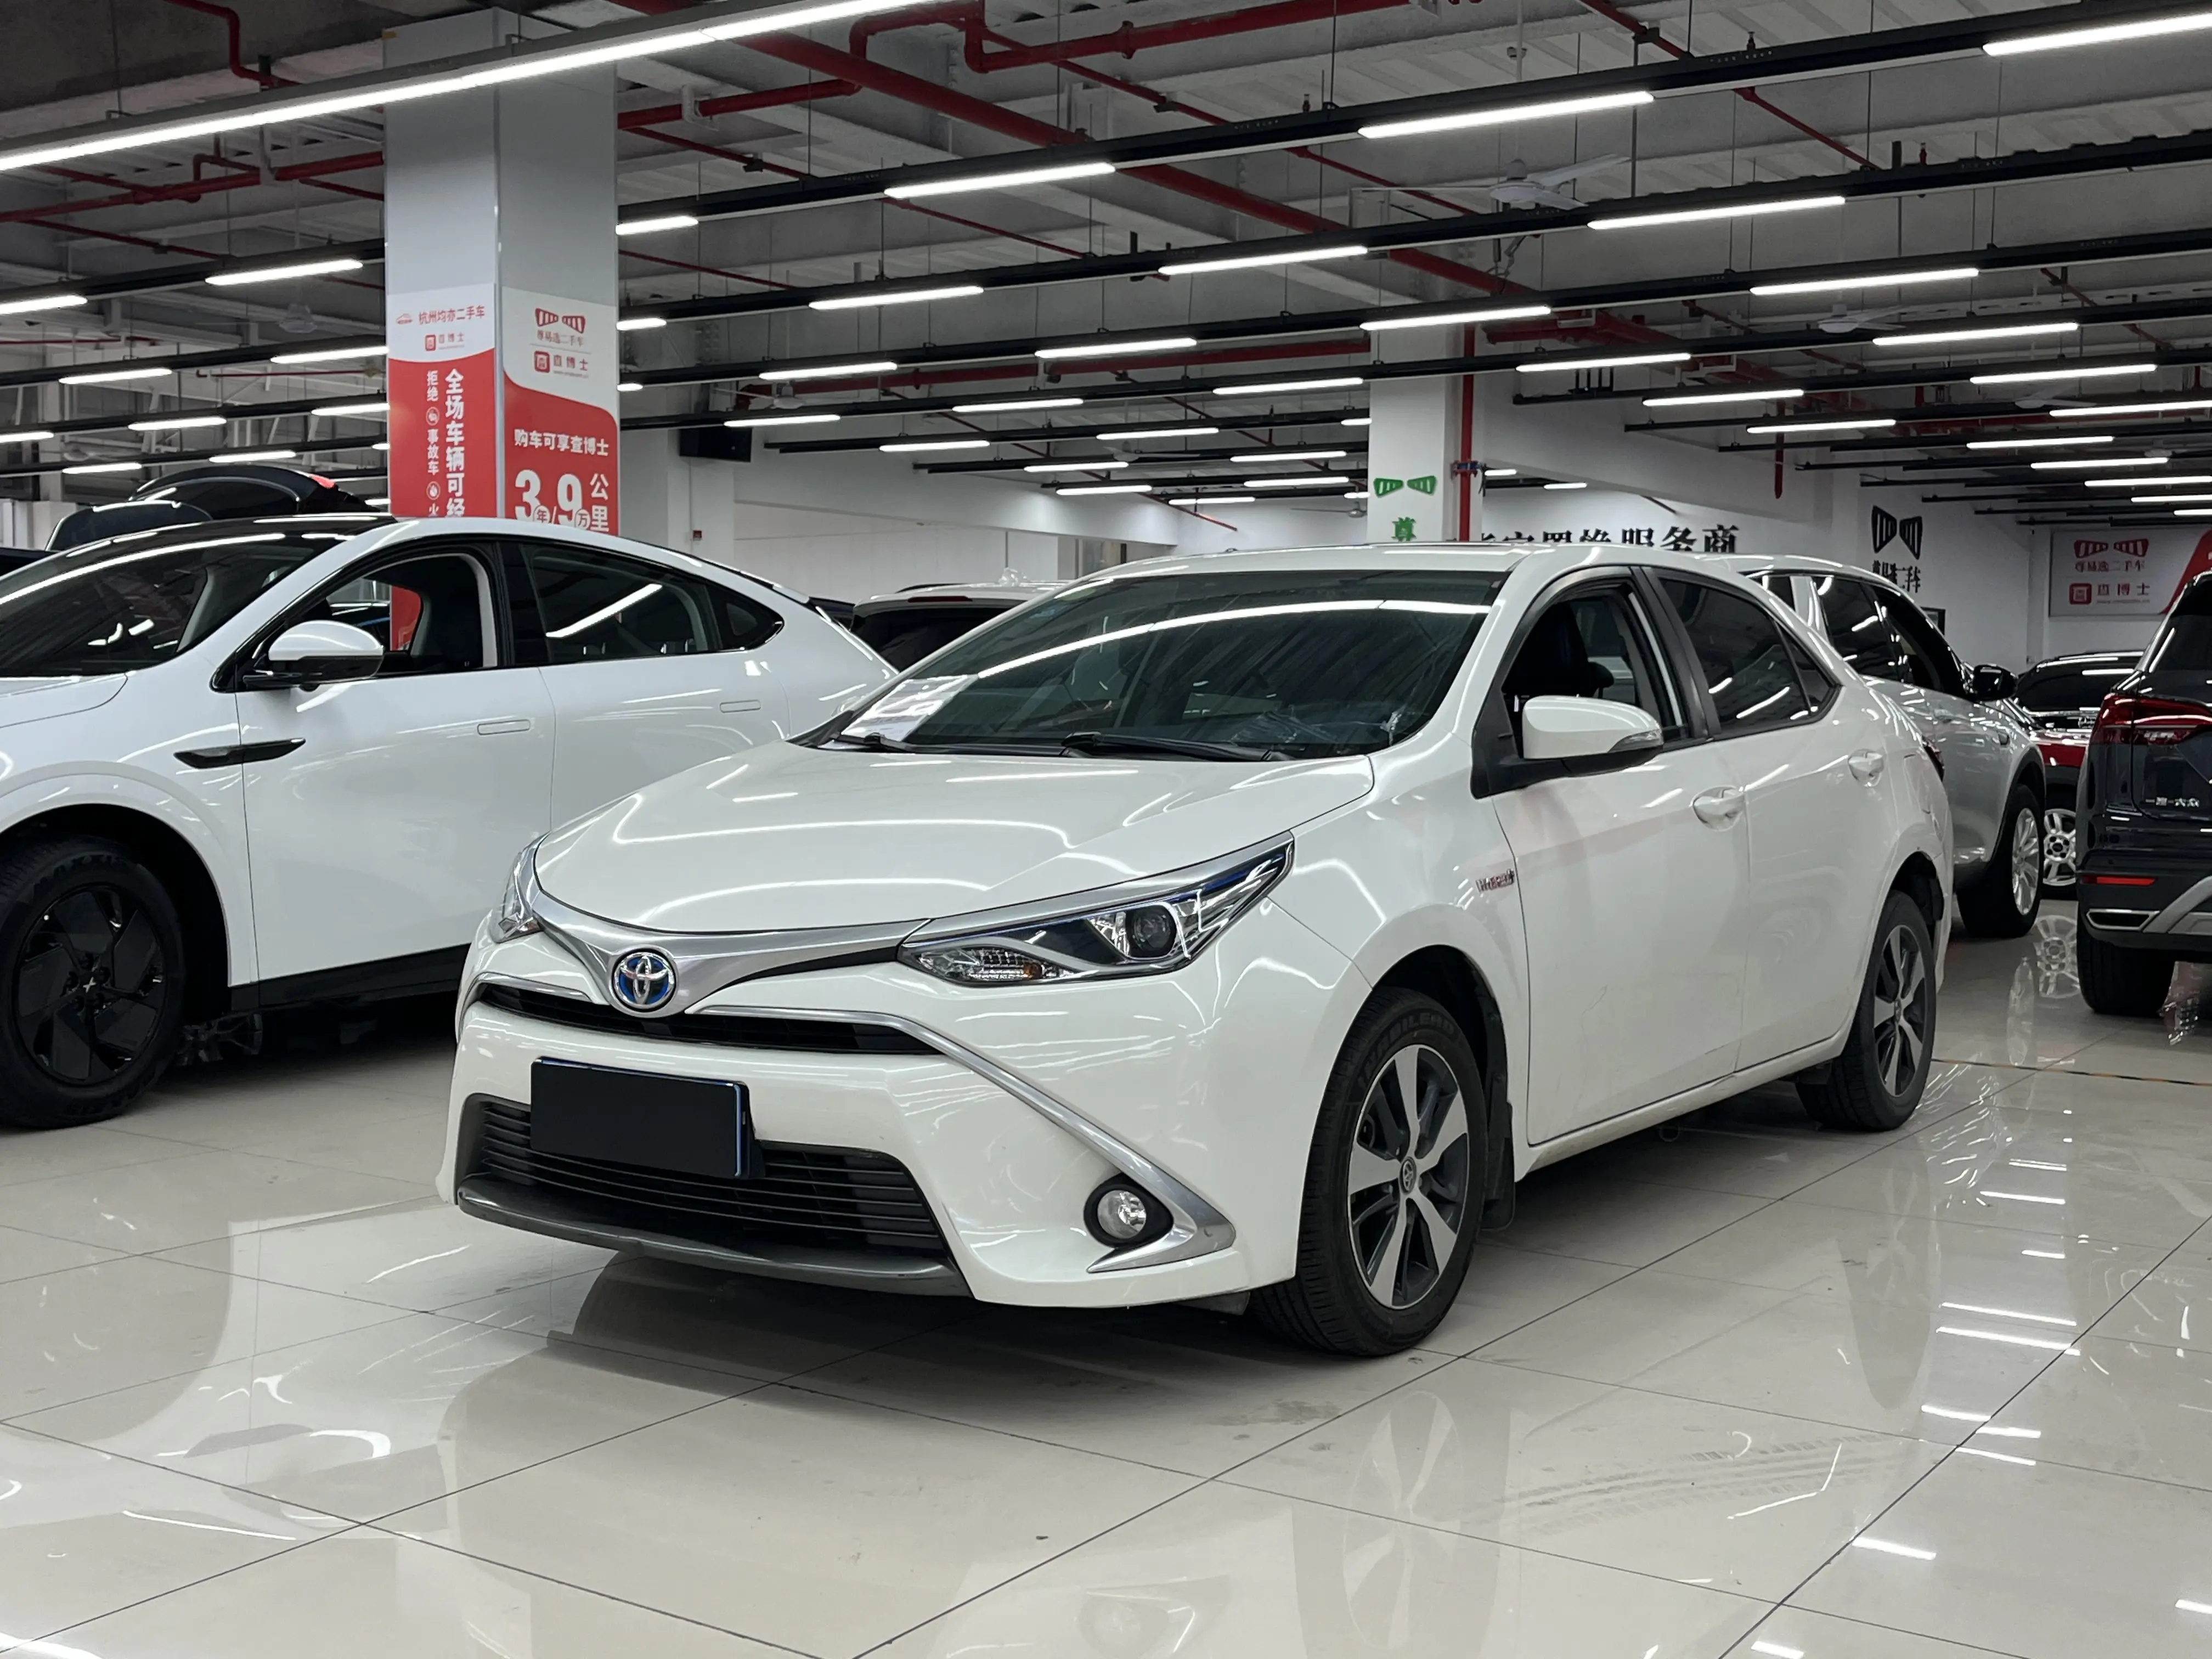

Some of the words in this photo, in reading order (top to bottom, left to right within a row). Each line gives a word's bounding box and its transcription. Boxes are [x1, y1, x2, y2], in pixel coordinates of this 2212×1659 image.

[419, 305, 485, 325] 杭州均亦二手车
[426, 370, 439, 402] 拒绝
[427, 428, 439, 476] 事故车
[514, 428, 609, 456] 购车可享查博士
